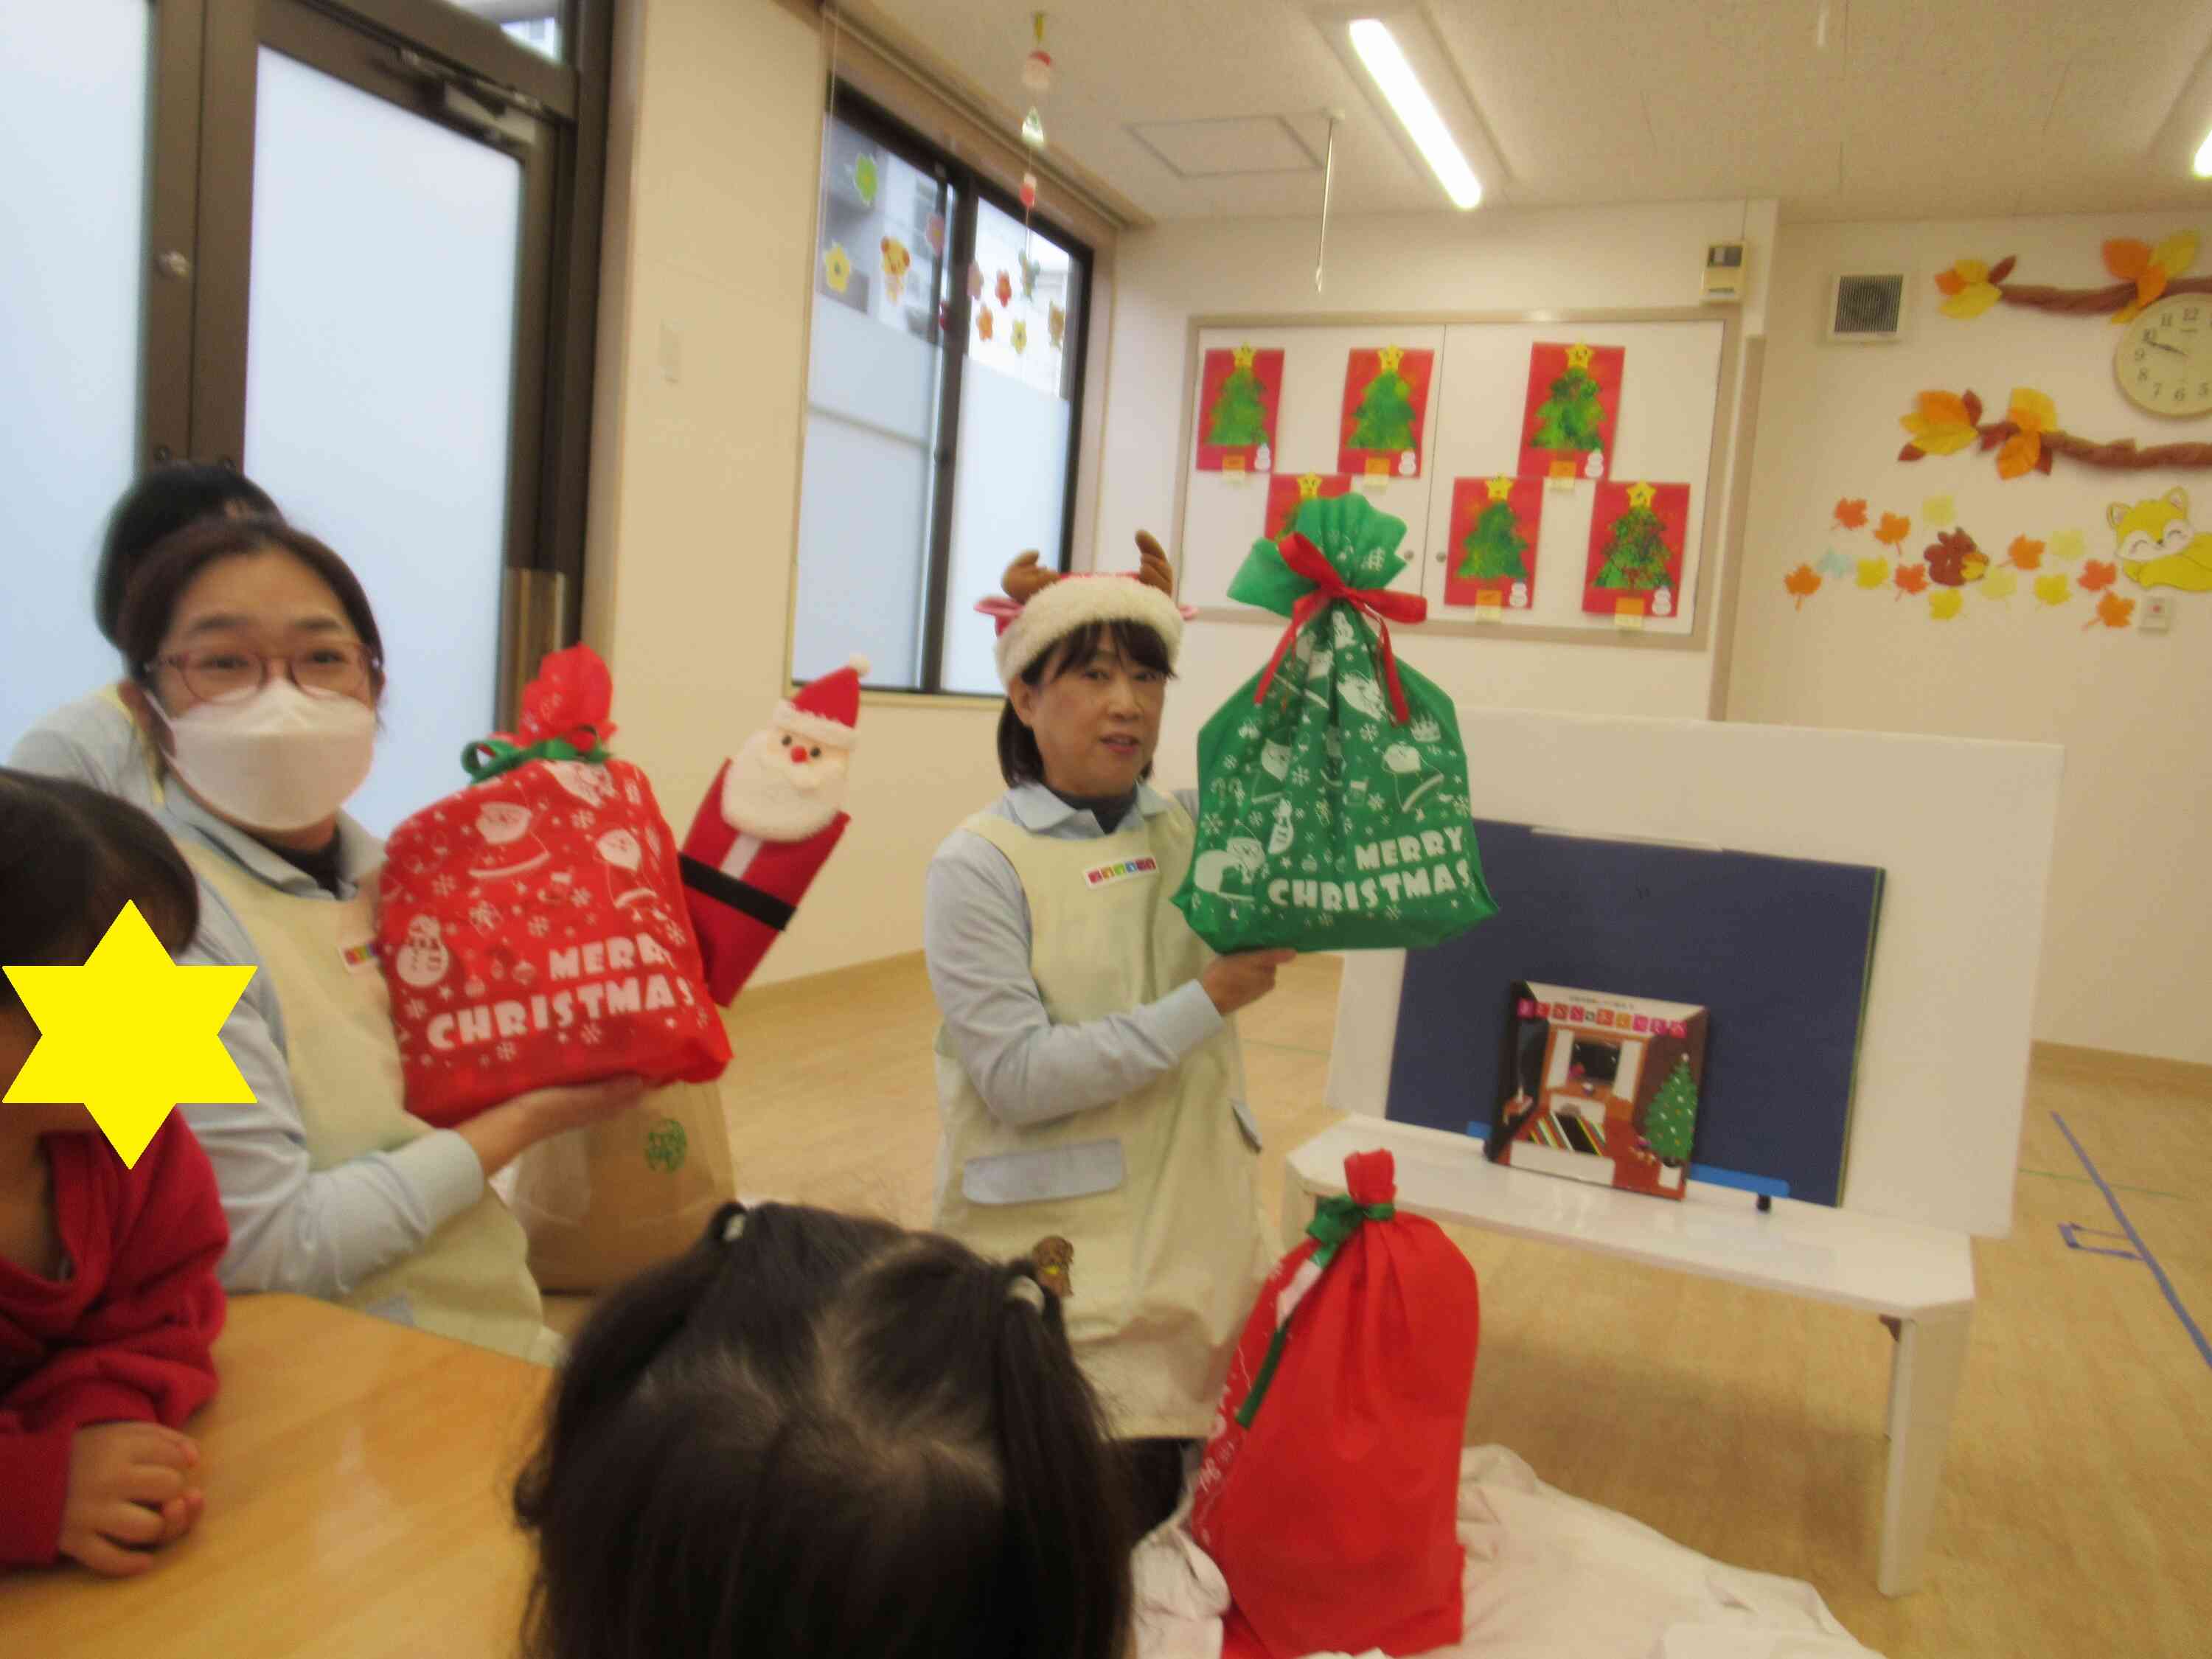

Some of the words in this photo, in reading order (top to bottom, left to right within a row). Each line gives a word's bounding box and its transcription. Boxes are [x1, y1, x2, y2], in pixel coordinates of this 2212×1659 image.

[1354, 825, 1464, 872] MERRY
[1267, 858, 1470, 911] CHRISTMAS
[548, 932, 676, 981] MERR
